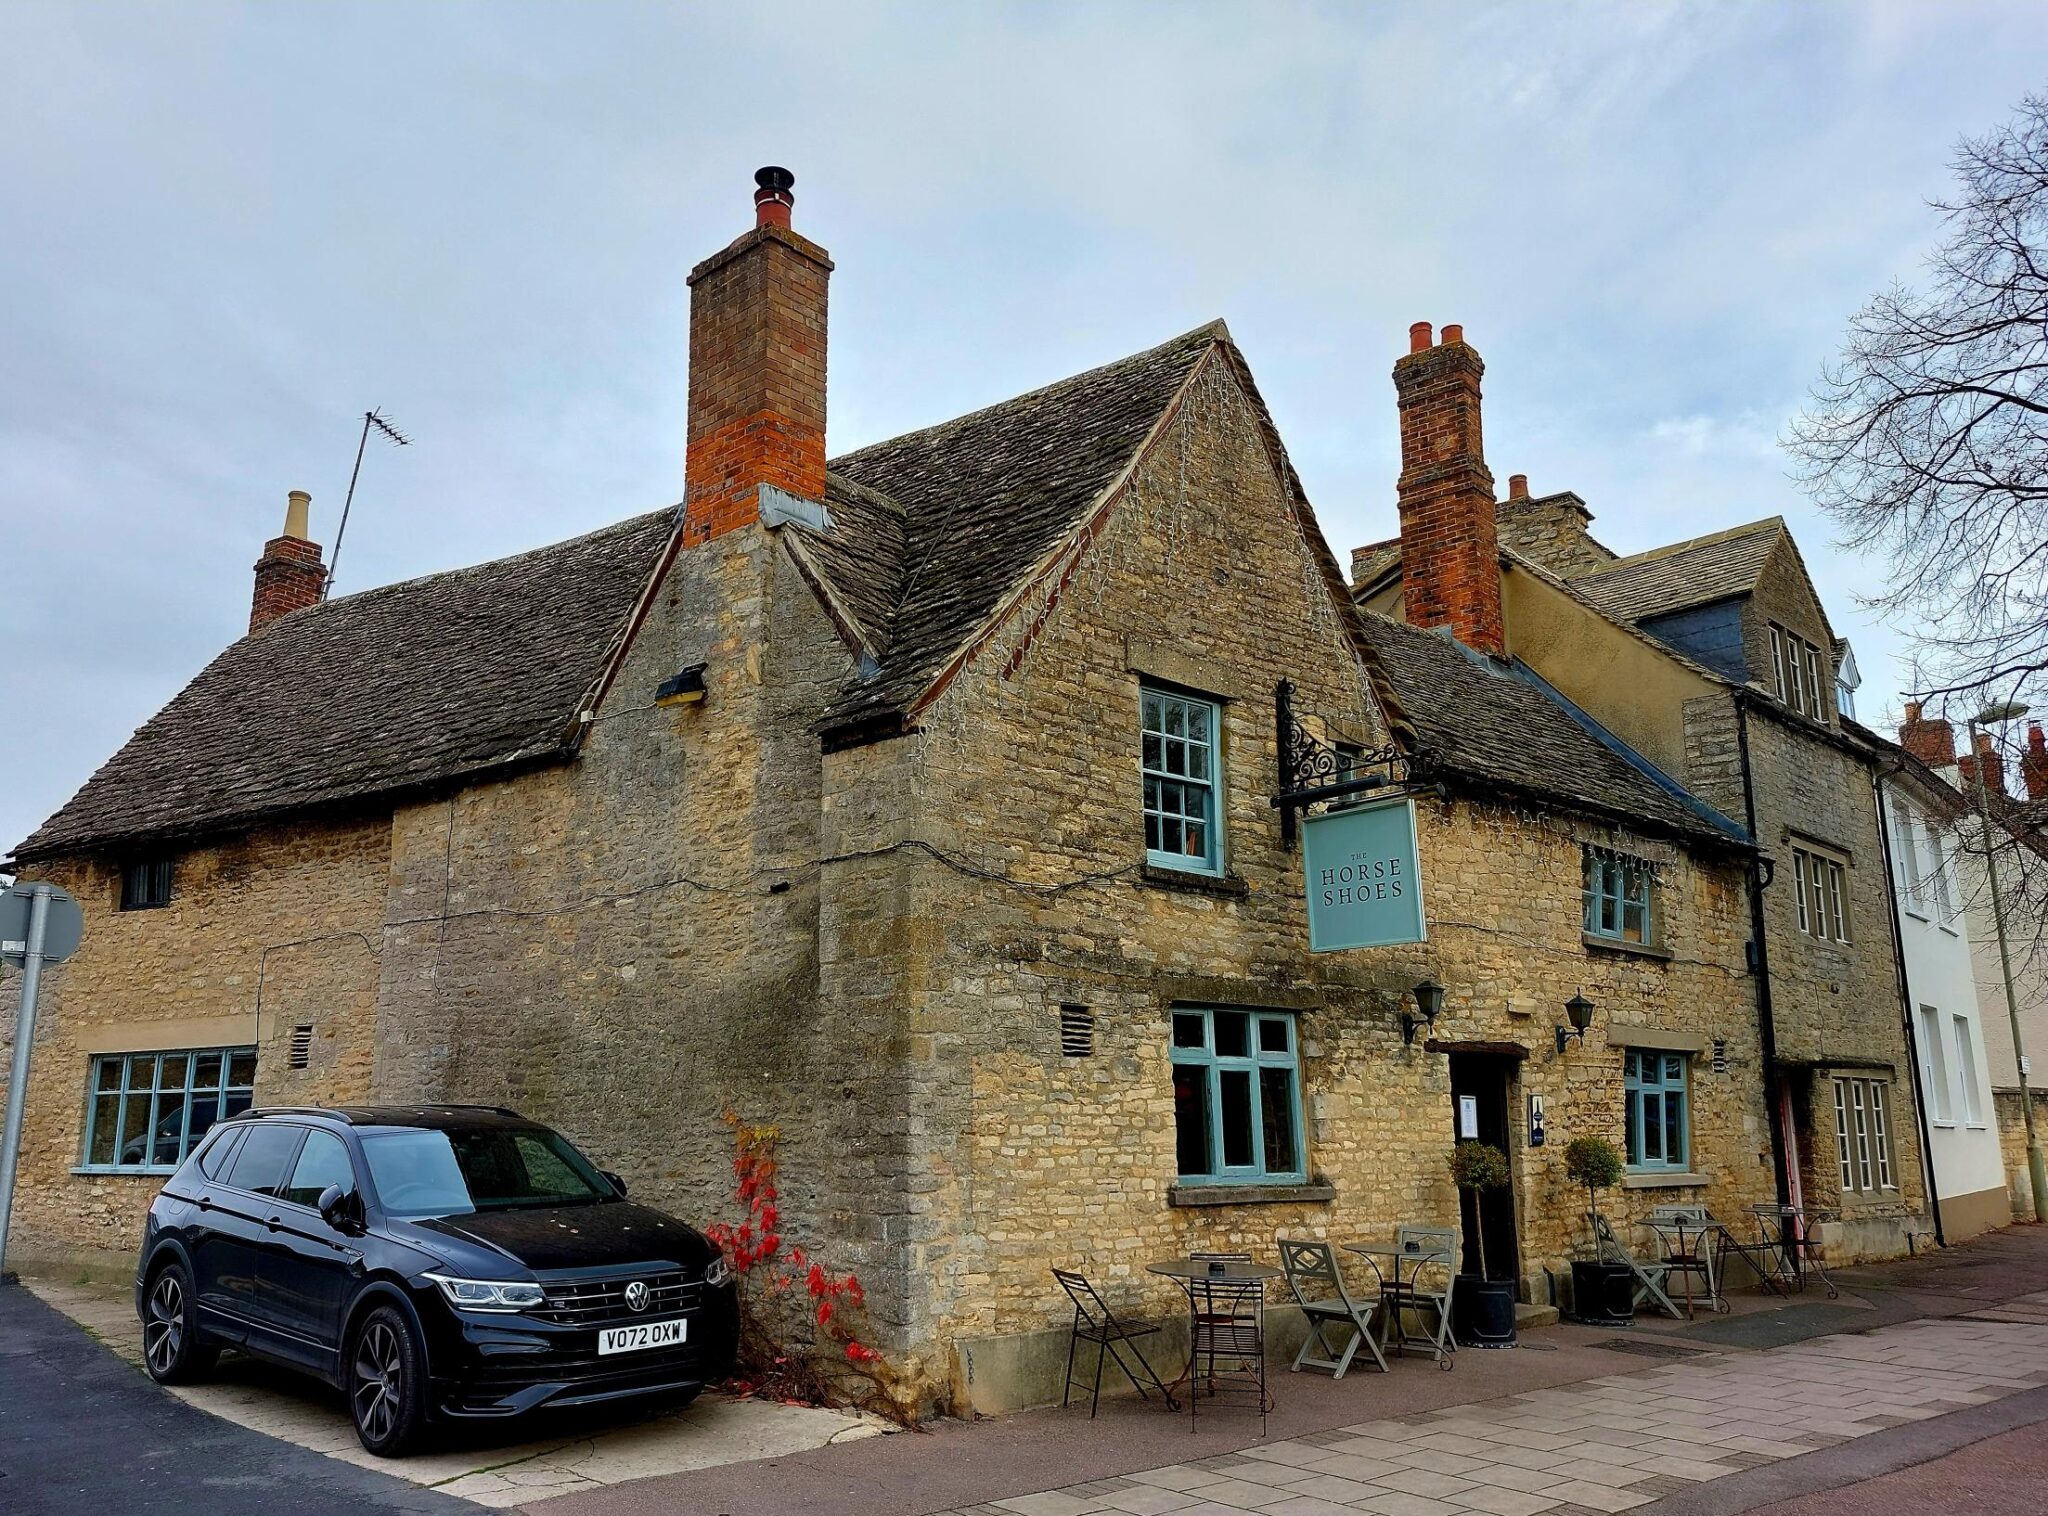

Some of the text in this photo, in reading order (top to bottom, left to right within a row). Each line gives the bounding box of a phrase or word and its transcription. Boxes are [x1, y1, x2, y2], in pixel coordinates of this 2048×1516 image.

[1351, 852, 1367, 861] THE
[1321, 858, 1401, 886] HORSE
[1324, 880, 1402, 907] SHOES
[607, 1321, 681, 1350] VO72 OXW
